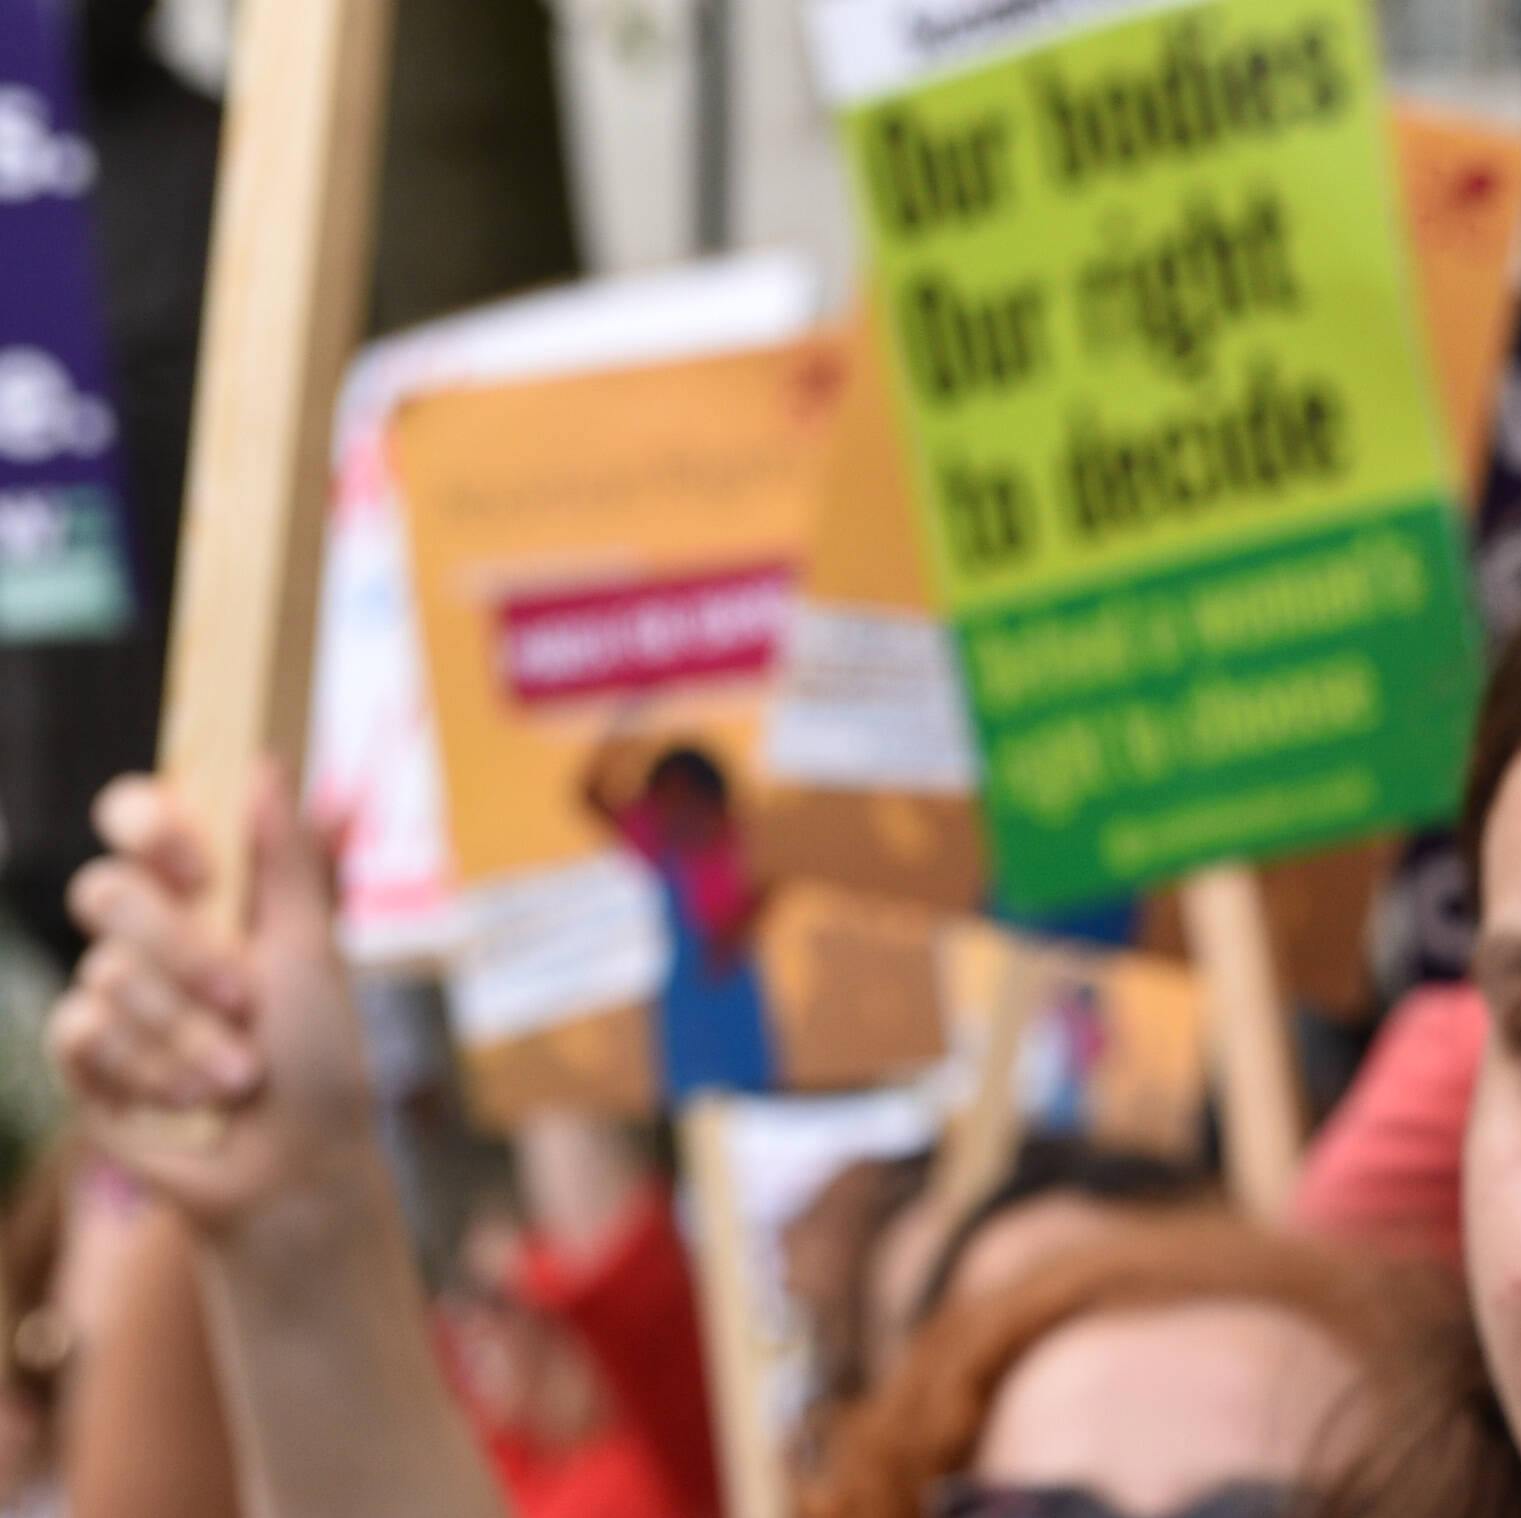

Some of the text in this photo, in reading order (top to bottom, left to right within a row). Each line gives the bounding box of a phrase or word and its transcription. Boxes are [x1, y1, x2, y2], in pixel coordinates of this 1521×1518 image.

[868, 22, 1350, 242] Our bodies
[903, 180, 1309, 409] Our right
[940, 450, 1034, 573] to
[1057, 352, 1352, 543] decide
